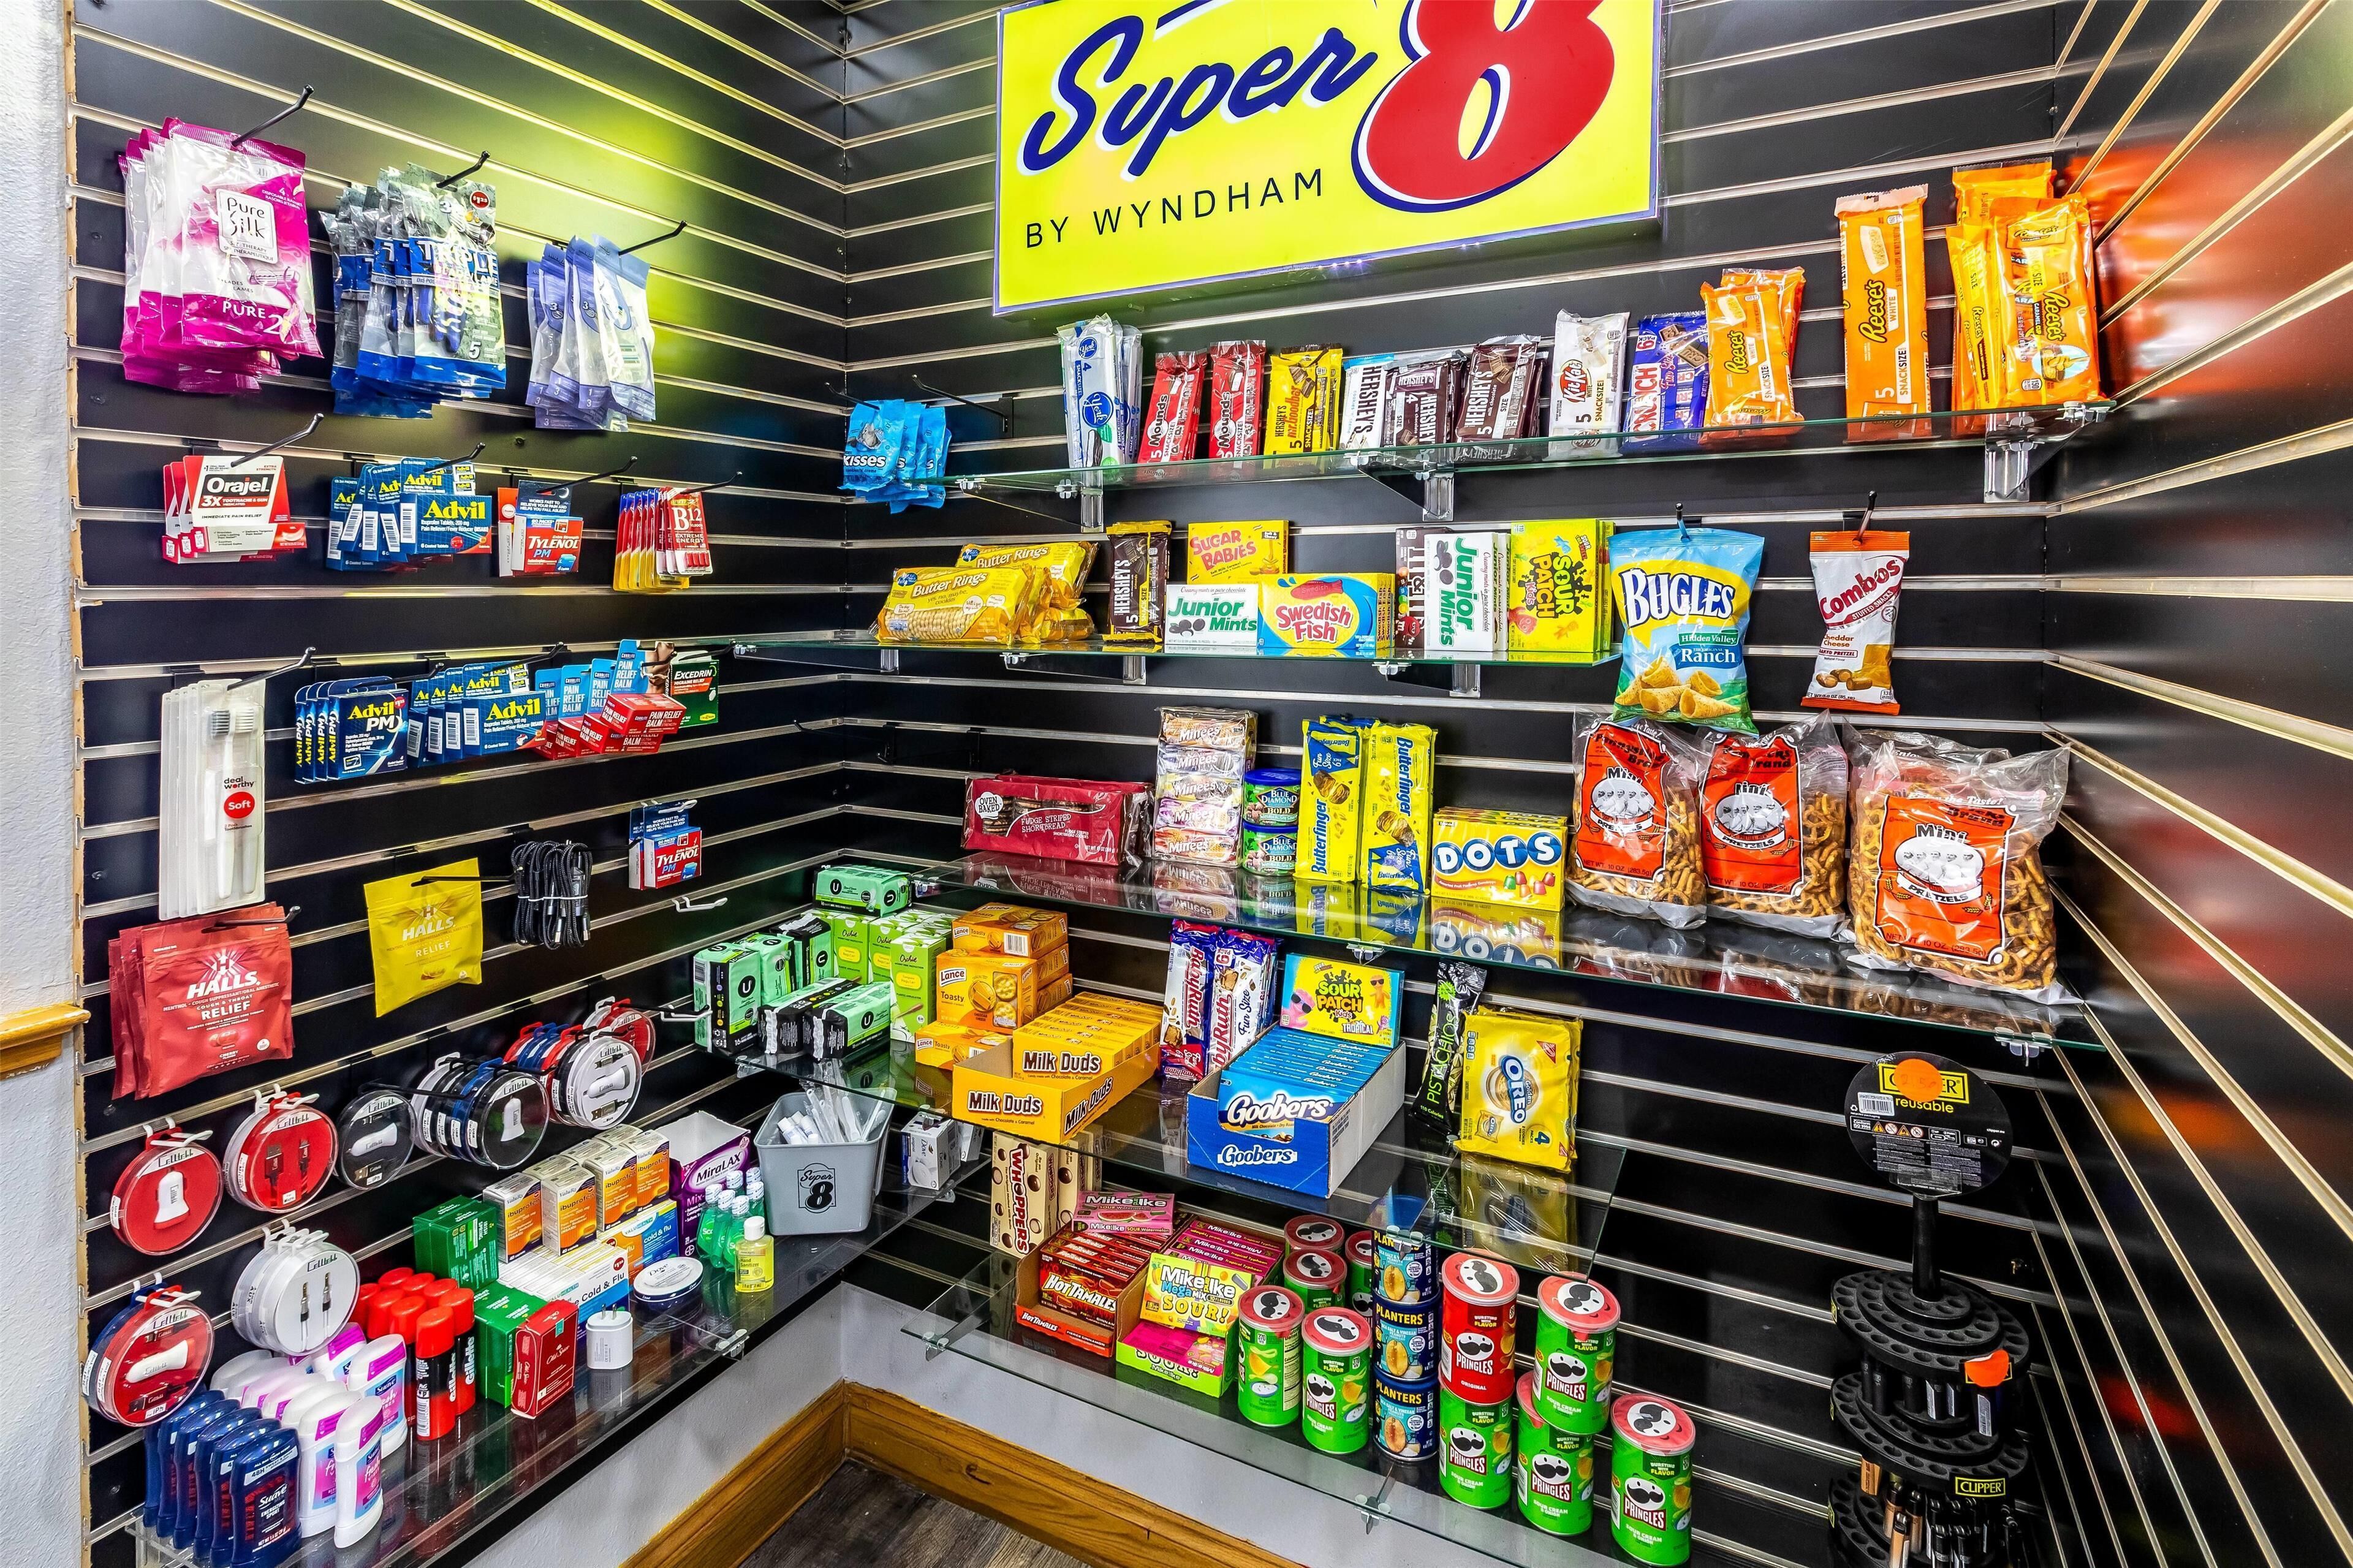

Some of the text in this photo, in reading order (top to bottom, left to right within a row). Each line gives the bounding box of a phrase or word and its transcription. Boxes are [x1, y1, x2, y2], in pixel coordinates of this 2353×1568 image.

[1018, 0, 1616, 213] Super 8
[227, 197, 265, 218] Pure
[1026, 168, 1322, 249] BY WYNDHAM
[230, 211, 265, 239] Silk
[222, 302, 284, 334] PURE 2
[1858, 279, 1887, 343] Reese's
[1888, 295, 1896, 322] WHITE
[2042, 292, 2070, 341] Reese's
[1724, 330, 1749, 374] Reese's
[1398, 373, 1434, 386] HERSHEY'S
[1563, 359, 1583, 403] KitKat
[1900, 350, 1908, 396] SNACKSIZE
[1084, 393, 1108, 425] York
[1355, 366, 1382, 434] HERSHEY'S
[1464, 371, 1494, 428] HERSHEY'S
[1149, 395, 1169, 446] Mounds
[1218, 391, 1231, 448] Mounds
[1275, 405, 1287, 437] HERSHEY'S
[1575, 414, 1591, 423] 5
[404, 474, 442, 487] Advil
[201, 496, 223, 507] 3X
[423, 500, 486, 520] Advil
[672, 507, 702, 531] B12
[528, 536, 580, 549] TYLENOL
[1189, 529, 1241, 555] SUGAR
[534, 549, 551, 558] PM
[977, 546, 1048, 567] Butter Rings
[1201, 540, 1257, 570] BABIES
[912, 572, 987, 599] Butter Rings
[1113, 559, 1132, 616] HERSHEY'S
[1454, 536, 1478, 631] Junior
[1533, 555, 1555, 618] PATCH
[1553, 555, 1575, 613] SOUR
[1819, 559, 1902, 621] Combos
[1168, 598, 1245, 616] Junior
[1619, 567, 1735, 628] BUGLES
[1851, 589, 1895, 620] STUFFED SNACKS
[1210, 618, 1257, 631] Mints
[1276, 601, 1352, 630] Swedish
[1440, 589, 1455, 646] Mints
[1292, 620, 1338, 643] Fish
[1681, 632, 1737, 645] Hidden Valley
[618, 661, 633, 670] PAIN
[1681, 645, 1737, 664] Ranch
[467, 676, 499, 689] Advil
[614, 679, 632, 688] BALM
[616, 670, 637, 679] RELIEF
[674, 669, 713, 680] EXCEDRIN
[564, 686, 580, 695] PAIN
[348, 701, 395, 720] Advil
[486, 698, 541, 721] Advil
[562, 703, 581, 713] BALM
[645, 719, 663, 727] BALM
[1178, 724, 1221, 742] Minees
[224, 776, 243, 784] deal
[1396, 737, 1414, 817] Butterfinger
[228, 800, 251, 811] Soft
[977, 803, 1000, 814] BAKED
[979, 796, 998, 806] OVEN
[1261, 795, 1298, 804] DIAMOND
[1021, 813, 1071, 826] FUDGE STRIPED
[1021, 822, 1066, 833] SHORTBREAD
[1168, 835, 1209, 853] Minees
[1311, 798, 1331, 875] Butterfinger
[1915, 823, 1971, 844] Mini
[657, 847, 699, 868] TYLENOL
[1434, 834, 1556, 868] DOTS
[953, 928, 969, 937] Lance
[415, 940, 451, 958] RELIEF
[940, 969, 965, 982] Lance
[941, 991, 964, 1003] Toasty
[1184, 946, 1205, 1029] BabyRuth
[1317, 981, 1360, 998] SOUR
[201, 1000, 251, 1021] RELIEF
[1317, 996, 1362, 1012] PATCH
[917, 1039, 933, 1047] Lance
[1023, 1051, 1101, 1073] Milk Duds
[1427, 1012, 1460, 1104] PISTACHIOS
[1502, 1057, 1526, 1123] OREO
[968, 1092, 1042, 1115] Milk Duds
[1064, 1077, 1113, 1134] Milk Duds
[1227, 1094, 1329, 1125] Goobers
[1428, 1108, 1444, 1119] Calories
[1895, 1097, 1954, 1113] reusable
[1222, 1144, 1294, 1164] Goobers
[695, 1151, 742, 1184] MiraLAX
[800, 1170, 834, 1186] Super
[605, 1171, 636, 1189] ibuprofen
[560, 1193, 594, 1211] ibuprofen
[806, 1180, 834, 1211] 8
[1009, 1148, 1029, 1254] WHOPPERS
[507, 1198, 540, 1218] ibuprofen
[582, 1271, 625, 1302] Cold & Flu
[1161, 1266, 1236, 1298] Mike Ike
[1162, 1295, 1229, 1324] SOUR!
[1376, 1305, 1423, 1325] PLANTERS
[464, 1336, 475, 1385] Gillette
[1456, 1355, 1493, 1375] PRINGLES
[1376, 1379, 1422, 1404] PLANTERS
[1546, 1372, 1585, 1400] PRINGLES
[1306, 1395, 1336, 1420] PRINGLES
[1449, 1445, 1486, 1473] PRINGLES
[251, 1468, 265, 1478] 48H
[260, 1484, 288, 1506] Suave
[1532, 1473, 1571, 1501] PRINGLES
[1960, 1482, 2003, 1493] CLIPPER
[1624, 1498, 1665, 1529] PRINGLES
